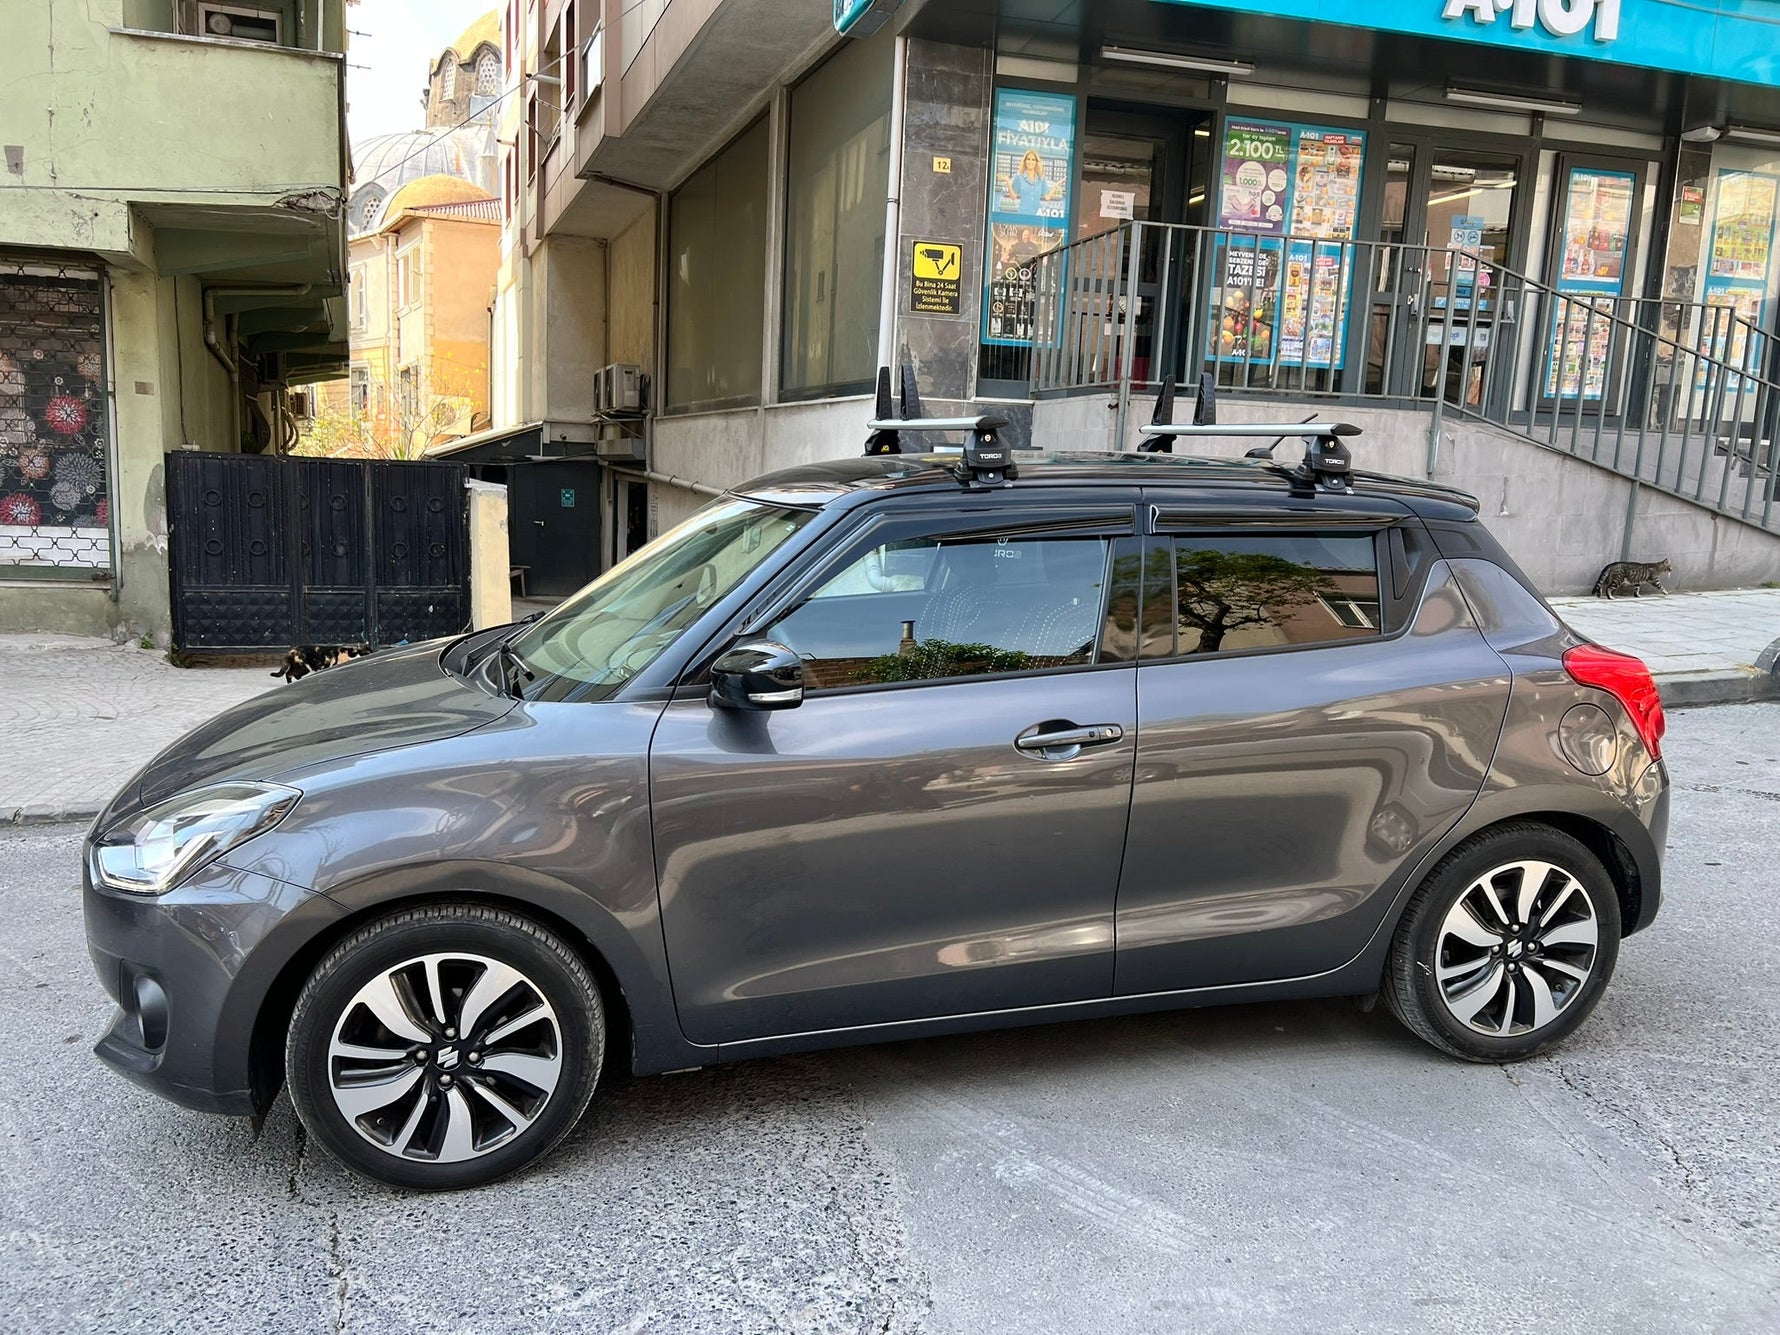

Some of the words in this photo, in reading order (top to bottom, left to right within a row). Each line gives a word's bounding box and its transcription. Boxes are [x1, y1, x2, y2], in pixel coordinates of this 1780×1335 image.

[1229, 138, 1273, 159] 2.100
[936, 281, 944, 289] 24
[944, 282, 957, 290] Saat
[913, 287, 937, 296] Güvenlik
[922, 295, 942, 303] Sistemi
